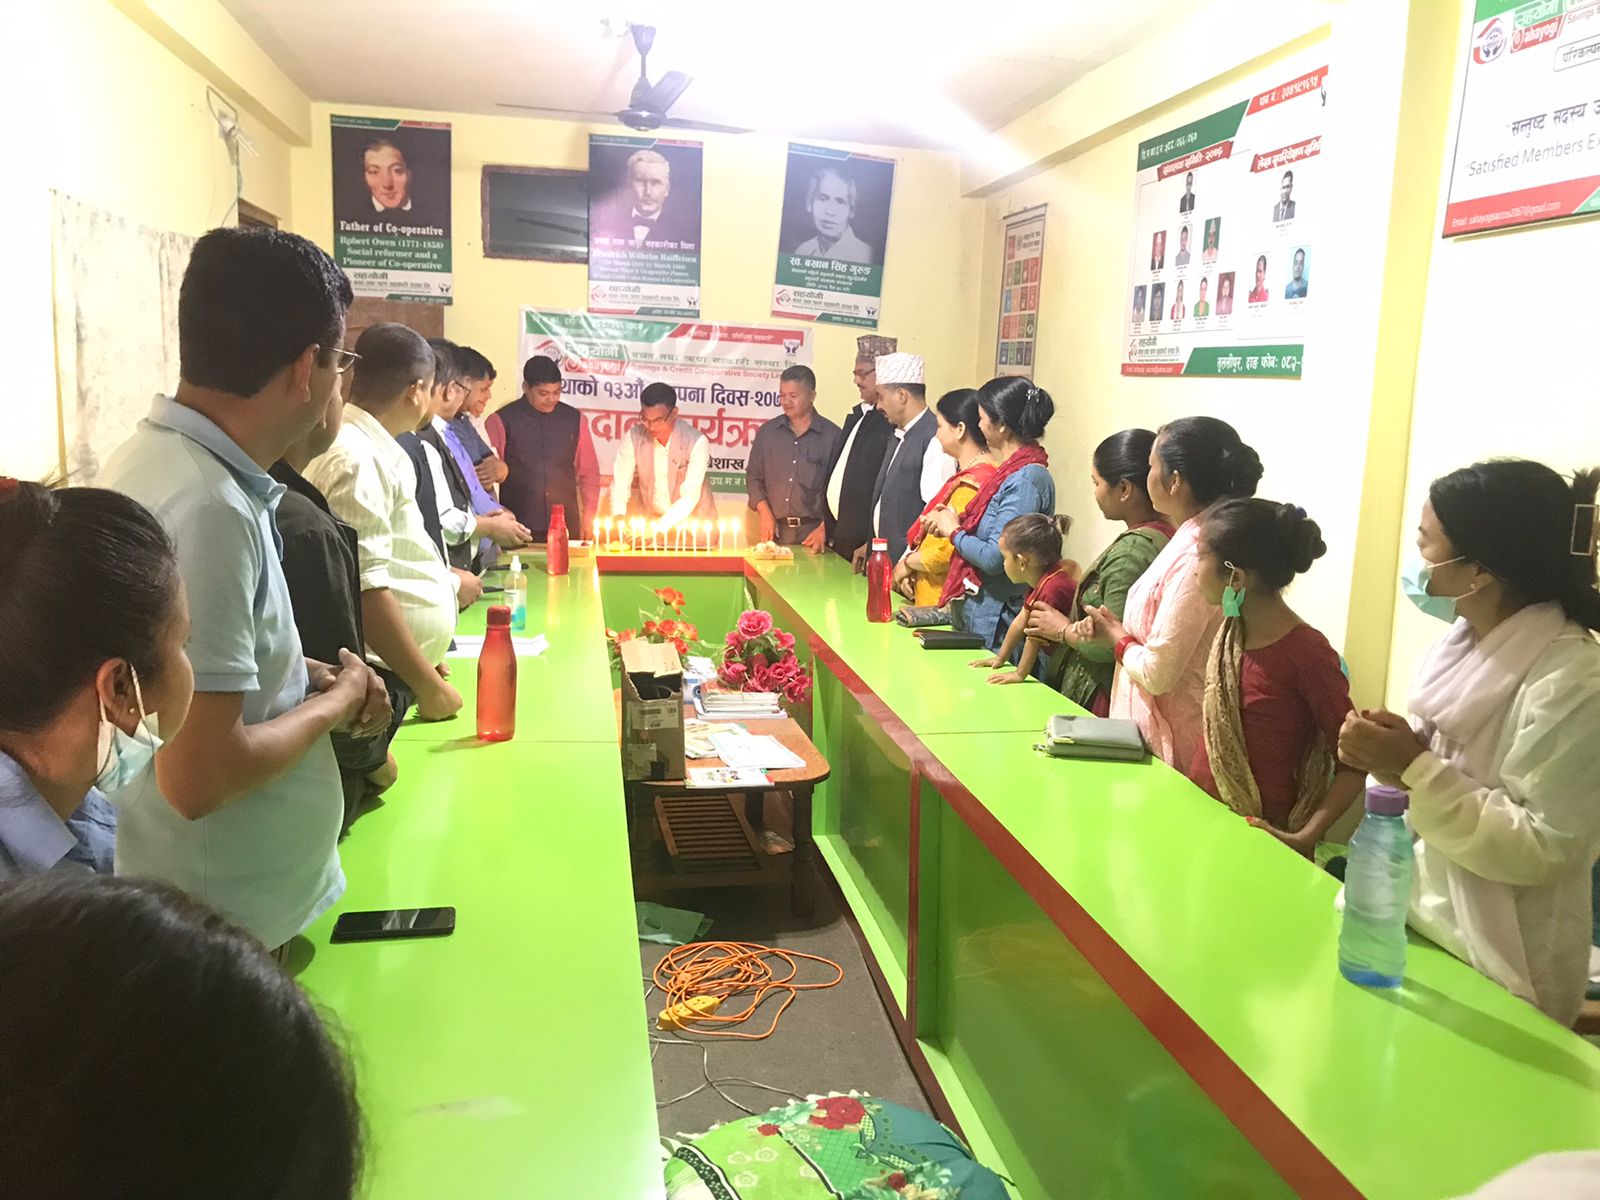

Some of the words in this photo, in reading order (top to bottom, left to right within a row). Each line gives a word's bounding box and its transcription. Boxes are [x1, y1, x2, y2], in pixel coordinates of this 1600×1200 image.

[1567, 9, 1594, 24] Savings
[1553, 103, 1588, 126] सदस्य
[1522, 139, 1583, 164] Members
[340, 221, 369, 232] Father
[373, 223, 382, 233] of
[386, 223, 443, 236] Co-operative
[372, 238, 396, 247] Owen
[347, 247, 373, 256] Social
[375, 248, 412, 257] reformer
[414, 250, 430, 259] and
[628, 252, 659, 261] Wilhelm
[343, 257, 376, 266] Pioneer
[378, 258, 387, 267] of
[389, 259, 442, 270] Co-operative
[670, 364, 694, 373] Credit
[743, 371, 769, 379] Society
